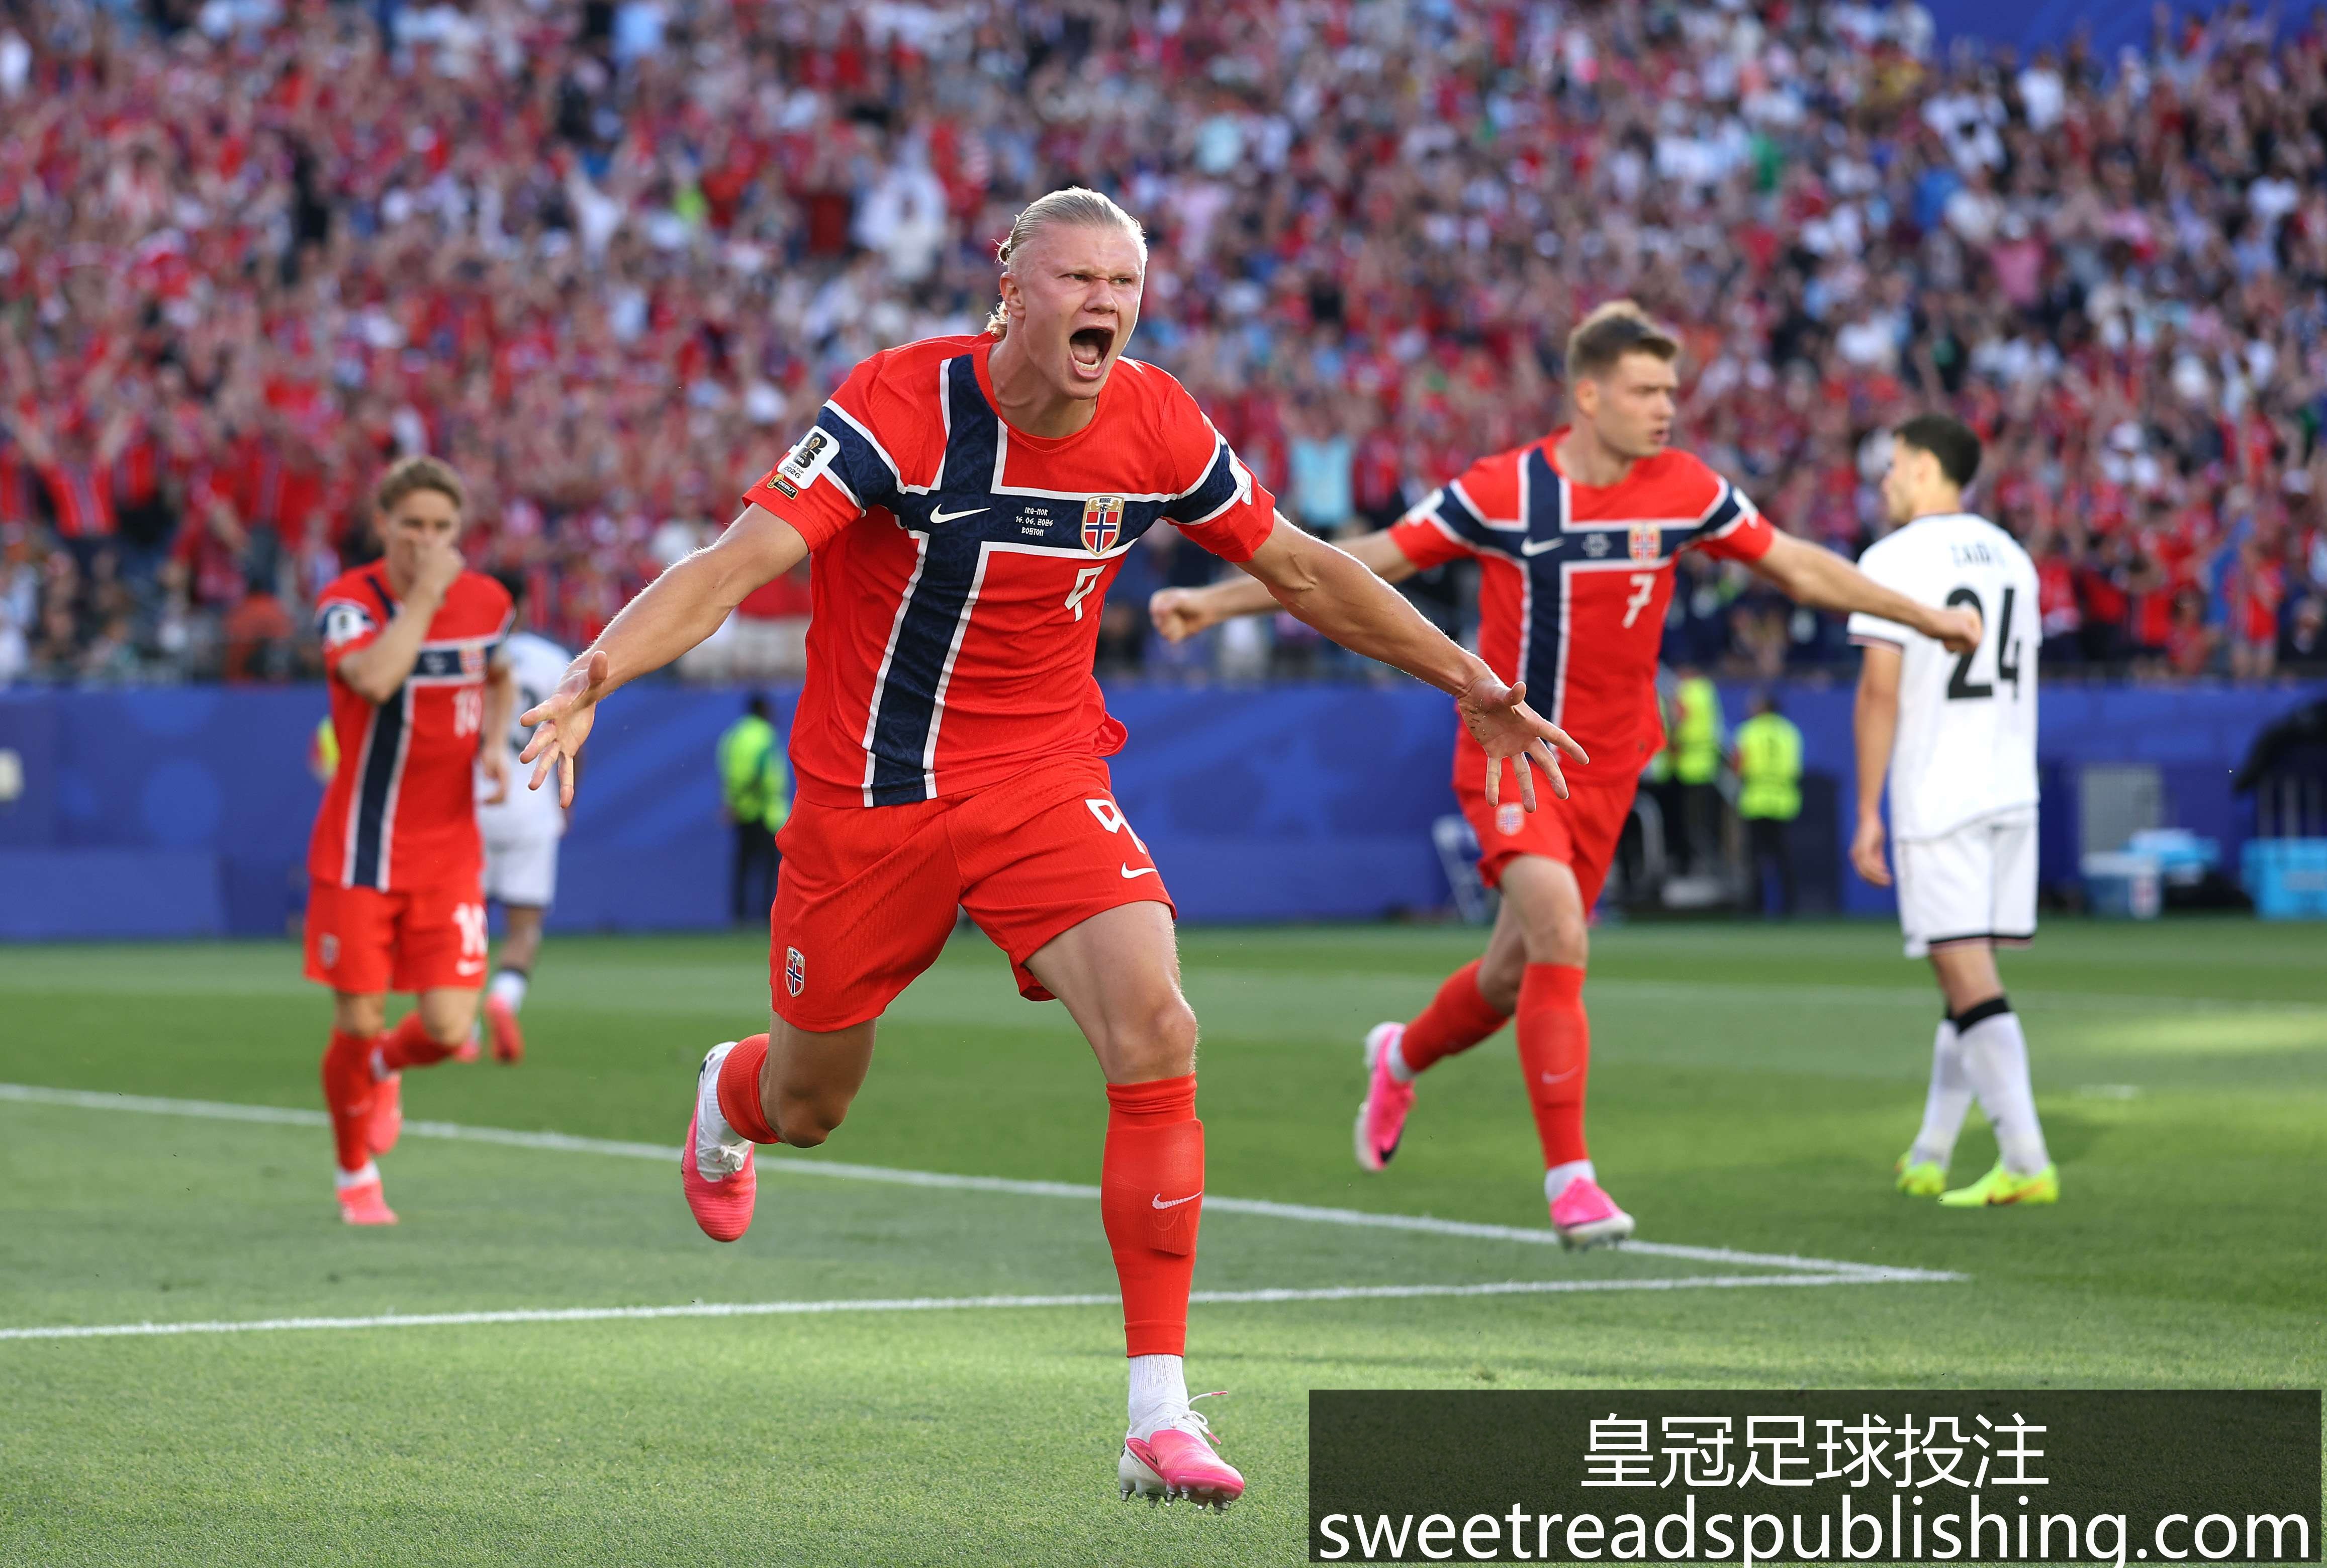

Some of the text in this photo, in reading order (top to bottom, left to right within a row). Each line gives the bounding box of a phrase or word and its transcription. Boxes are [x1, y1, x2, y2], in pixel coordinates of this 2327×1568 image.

[796, 456, 805, 464] FIFA
[784, 465, 801, 479] 2026
[778, 480, 796, 494] DEBUT
[1024, 507, 1049, 516] IRQ-NOR
[1021, 526, 1044, 537] BOSTON
[1064, 564, 1107, 622] 9
[1621, 572, 1657, 629] 7
[1945, 586, 2021, 702] 24
[1084, 799, 1147, 855] 9
